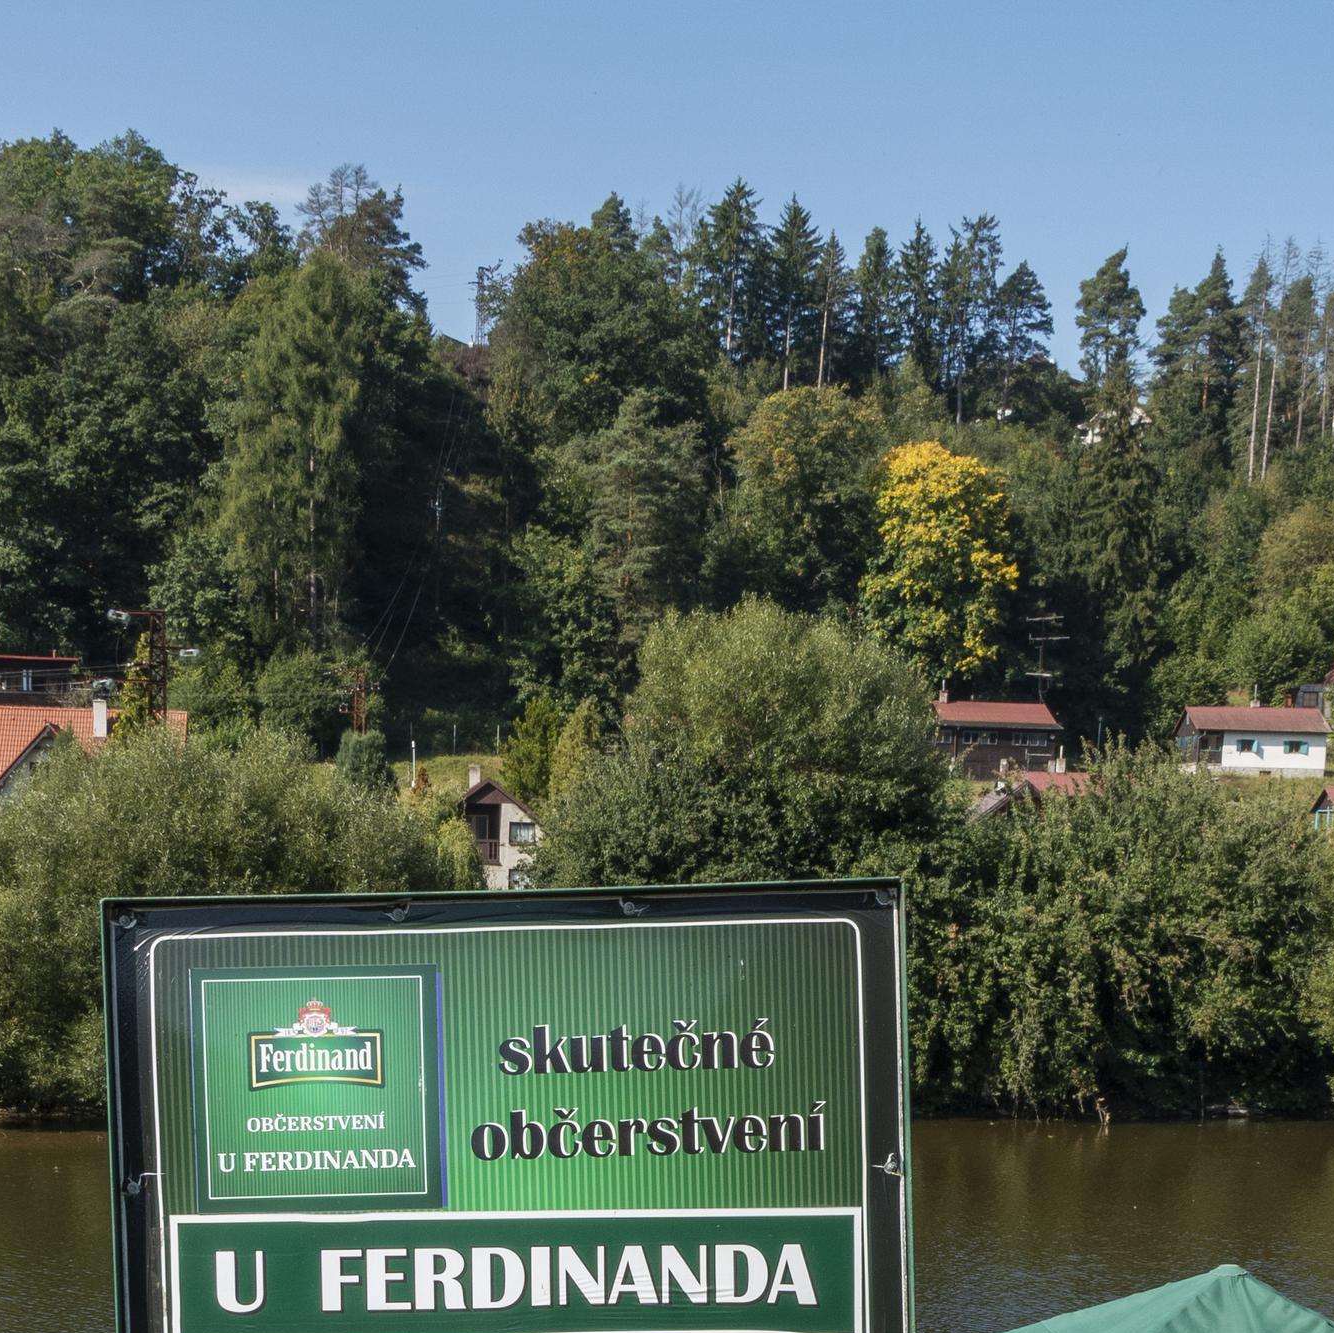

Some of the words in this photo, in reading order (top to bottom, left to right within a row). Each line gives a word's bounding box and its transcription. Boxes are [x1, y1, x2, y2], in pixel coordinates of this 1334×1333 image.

[259, 1041, 372, 1073] Ferdinand
[498, 1018, 775, 1076] skutečné
[247, 1111, 385, 1133] OBČERSTVENÍ
[471, 1101, 827, 1161] občerstvení
[218, 1152, 236, 1172] U
[243, 1148, 416, 1172] FERDINANDA
[215, 1250, 265, 1316] U
[319, 1243, 819, 1314] FERDINANDA
